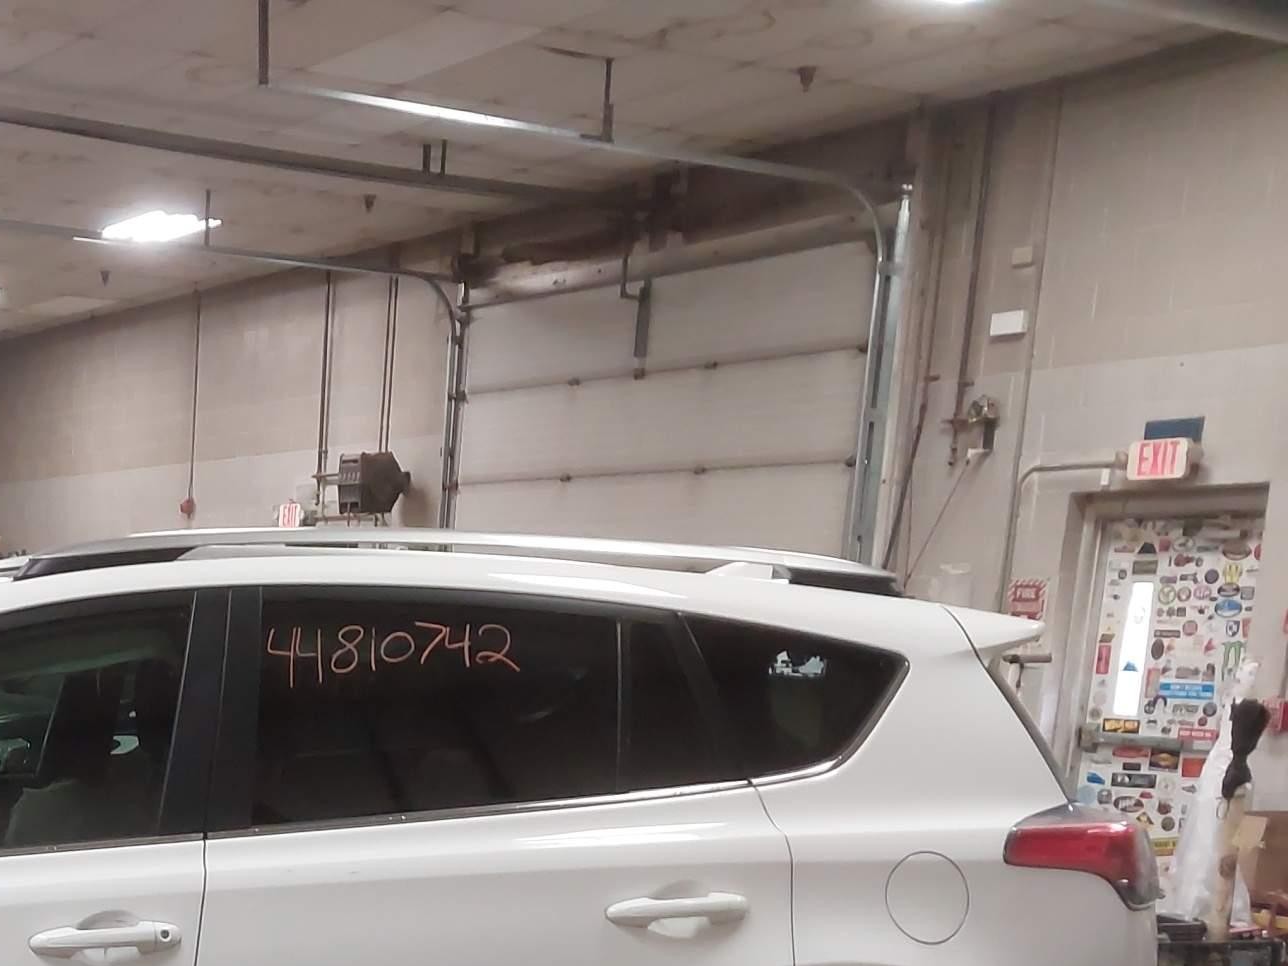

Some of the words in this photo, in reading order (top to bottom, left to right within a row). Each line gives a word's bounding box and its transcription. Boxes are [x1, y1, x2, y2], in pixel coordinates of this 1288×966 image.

[1137, 441, 1181, 477] EXIT
[282, 502, 300, 527] EXIT
[267, 621, 521, 688] 44810742
